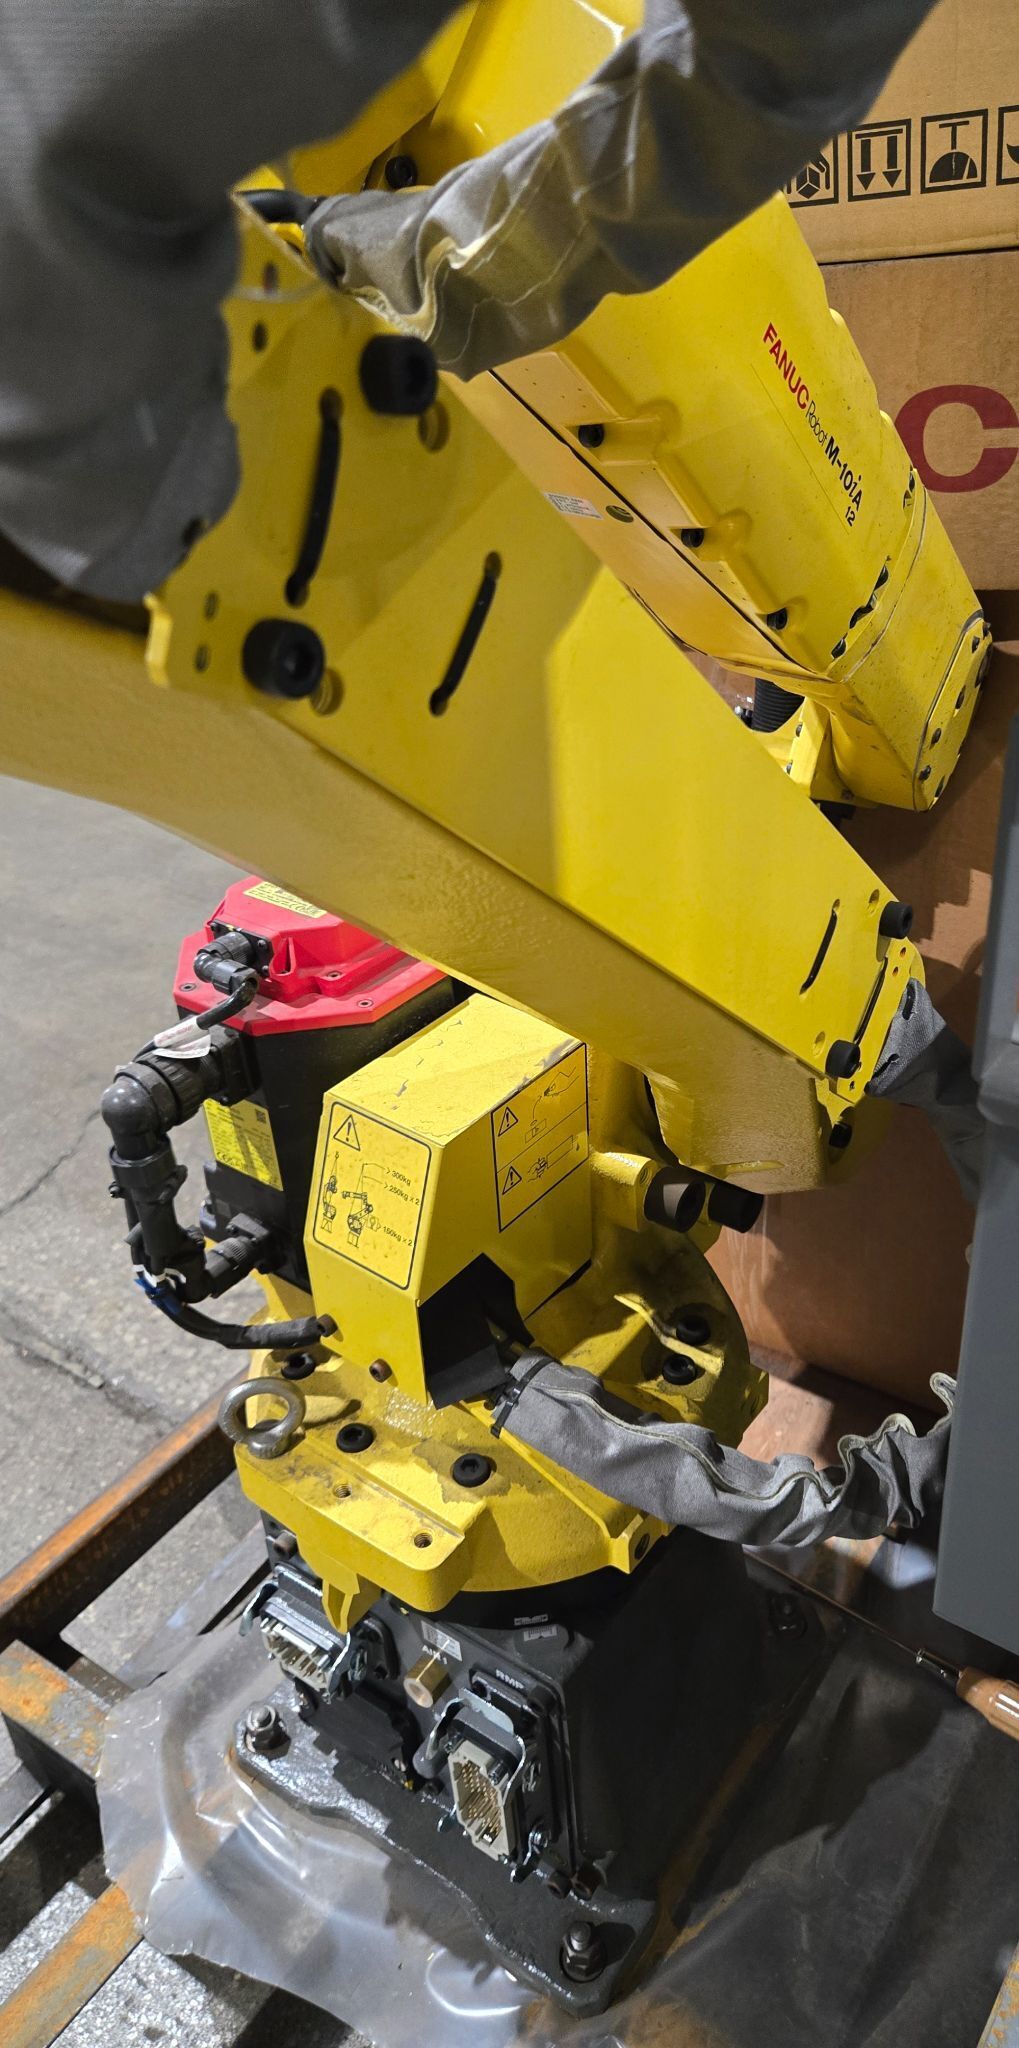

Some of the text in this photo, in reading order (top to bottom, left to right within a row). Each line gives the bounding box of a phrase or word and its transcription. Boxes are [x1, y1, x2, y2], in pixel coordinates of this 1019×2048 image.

[763, 322, 864, 511] FANUC Robot M-10iA
[894, 384, 1019, 493] C
[845, 506, 856, 527] 12
[495, 1668, 525, 1690] RMP
